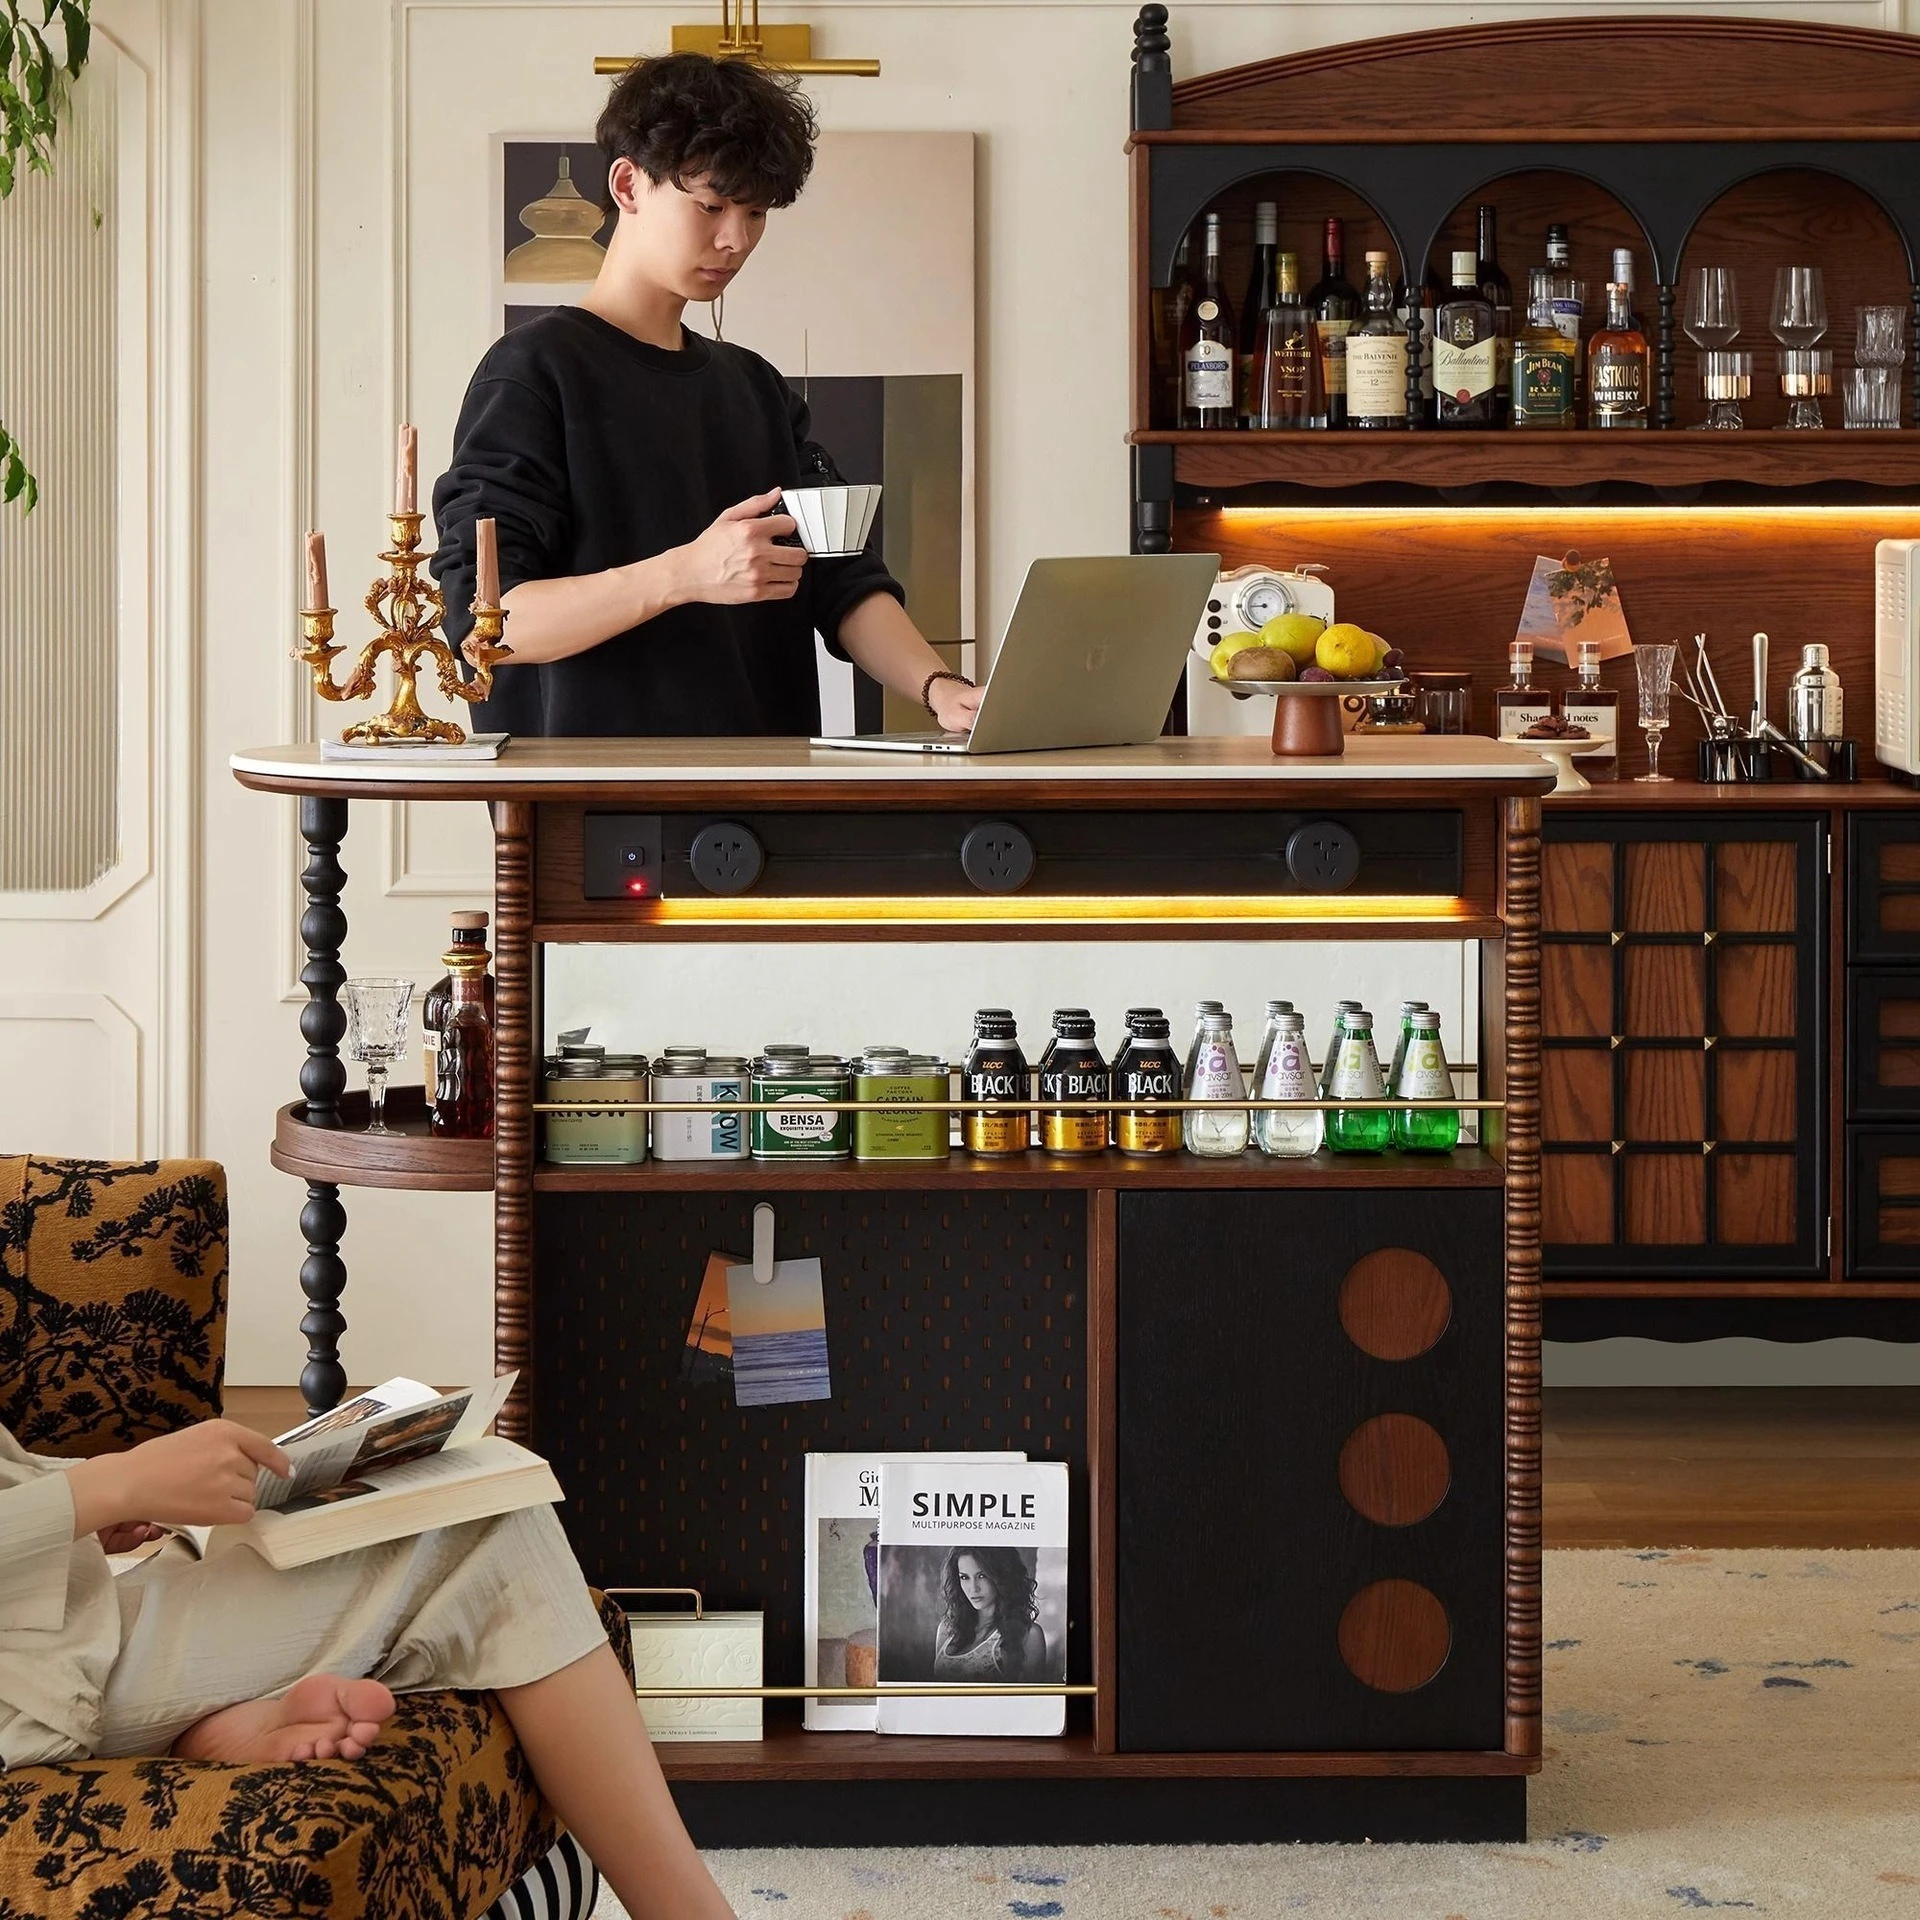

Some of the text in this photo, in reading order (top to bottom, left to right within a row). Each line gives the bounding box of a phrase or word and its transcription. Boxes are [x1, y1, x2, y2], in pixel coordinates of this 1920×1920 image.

[1437, 350, 1490, 366] Ballantine's
[1526, 358, 1562, 375] JIM BEAM
[1594, 391, 1639, 401] WHISKY
[1520, 713, 1541, 722] Sha
[1573, 713, 1599, 722] notes
[971, 1074, 1015, 1094] BLACK
[1068, 1074, 1108, 1094] BLACK
[1128, 1073, 1172, 1094] BLACK
[719, 1085, 738, 1150] KOW
[780, 1115, 824, 1125] BENSA
[912, 1492, 1035, 1518] SIMPLE
[912, 1521, 1036, 1530] MULTIPURPOSE MAGAZINE
